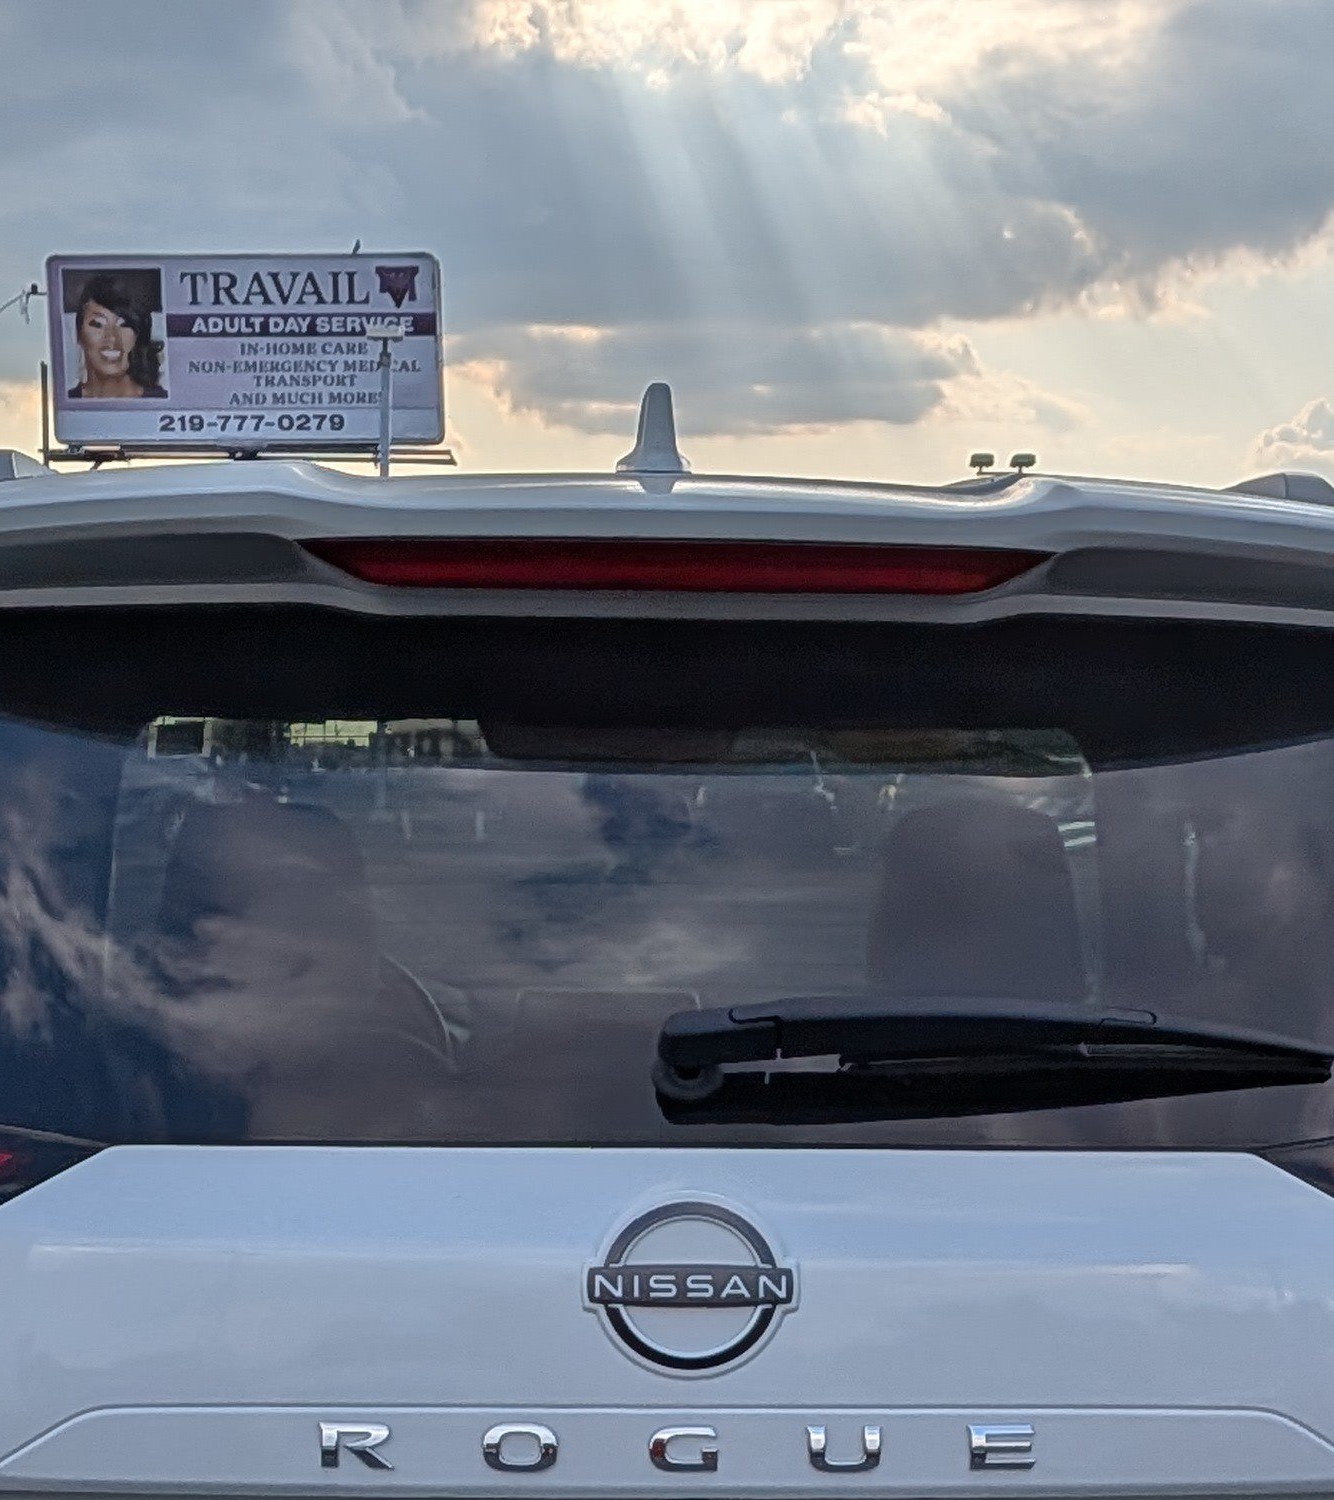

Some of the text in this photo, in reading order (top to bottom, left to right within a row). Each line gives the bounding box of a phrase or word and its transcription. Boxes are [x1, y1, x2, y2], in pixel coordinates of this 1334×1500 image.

[179, 271, 370, 305] TRAVAIL
[192, 316, 264, 334] ADULT
[269, 316, 311, 333] DAY
[240, 343, 368, 355] IN-HOME CARE
[188, 360, 338, 373] NON-EMERGENCY
[254, 374, 357, 387] TRANSPORT
[229, 391, 267, 405] AND
[271, 391, 324, 405] MUCH
[159, 413, 345, 432] 219-777-0279
[593, 1272, 788, 1299] NISSAN
[318, 1421, 1036, 1472] ROGUE
